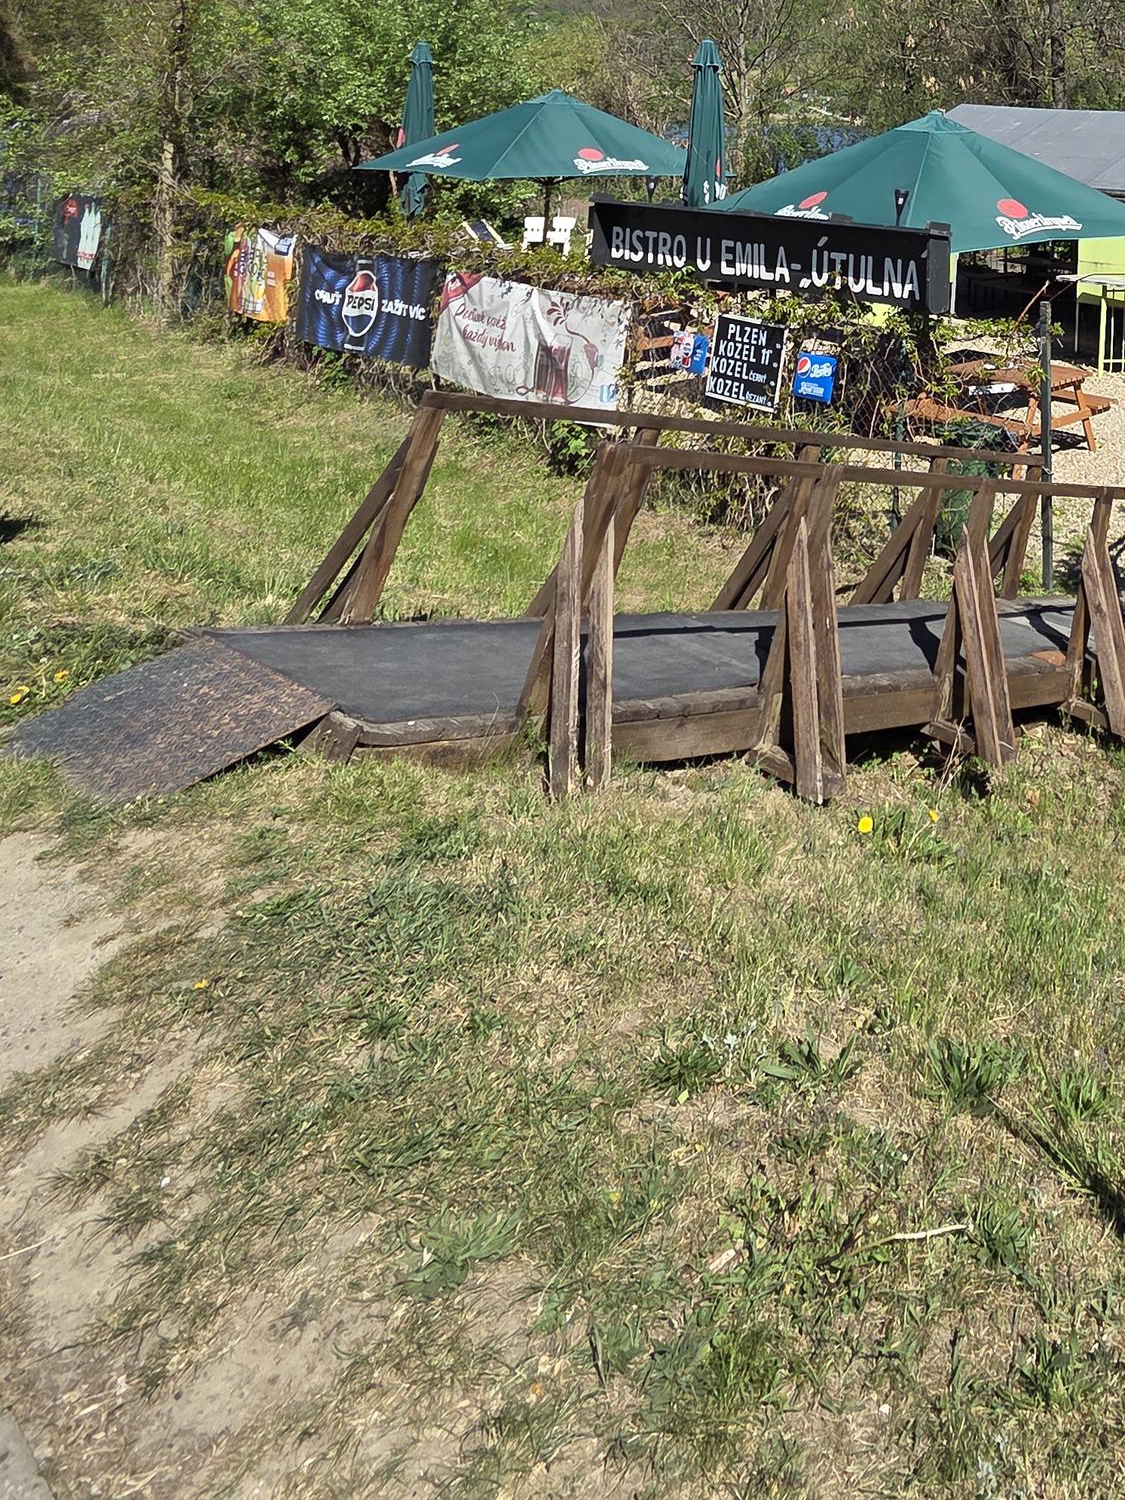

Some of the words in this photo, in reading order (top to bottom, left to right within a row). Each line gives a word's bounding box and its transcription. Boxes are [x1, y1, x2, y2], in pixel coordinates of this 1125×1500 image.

[611, 226, 687, 268] BISTRO
[696, 236, 711, 272] U
[346, 295, 376, 312] PEPSI
[719, 340, 756, 363] KOZEL
[711, 356, 748, 380] KOZEL
[708, 376, 745, 400] KOZEL
